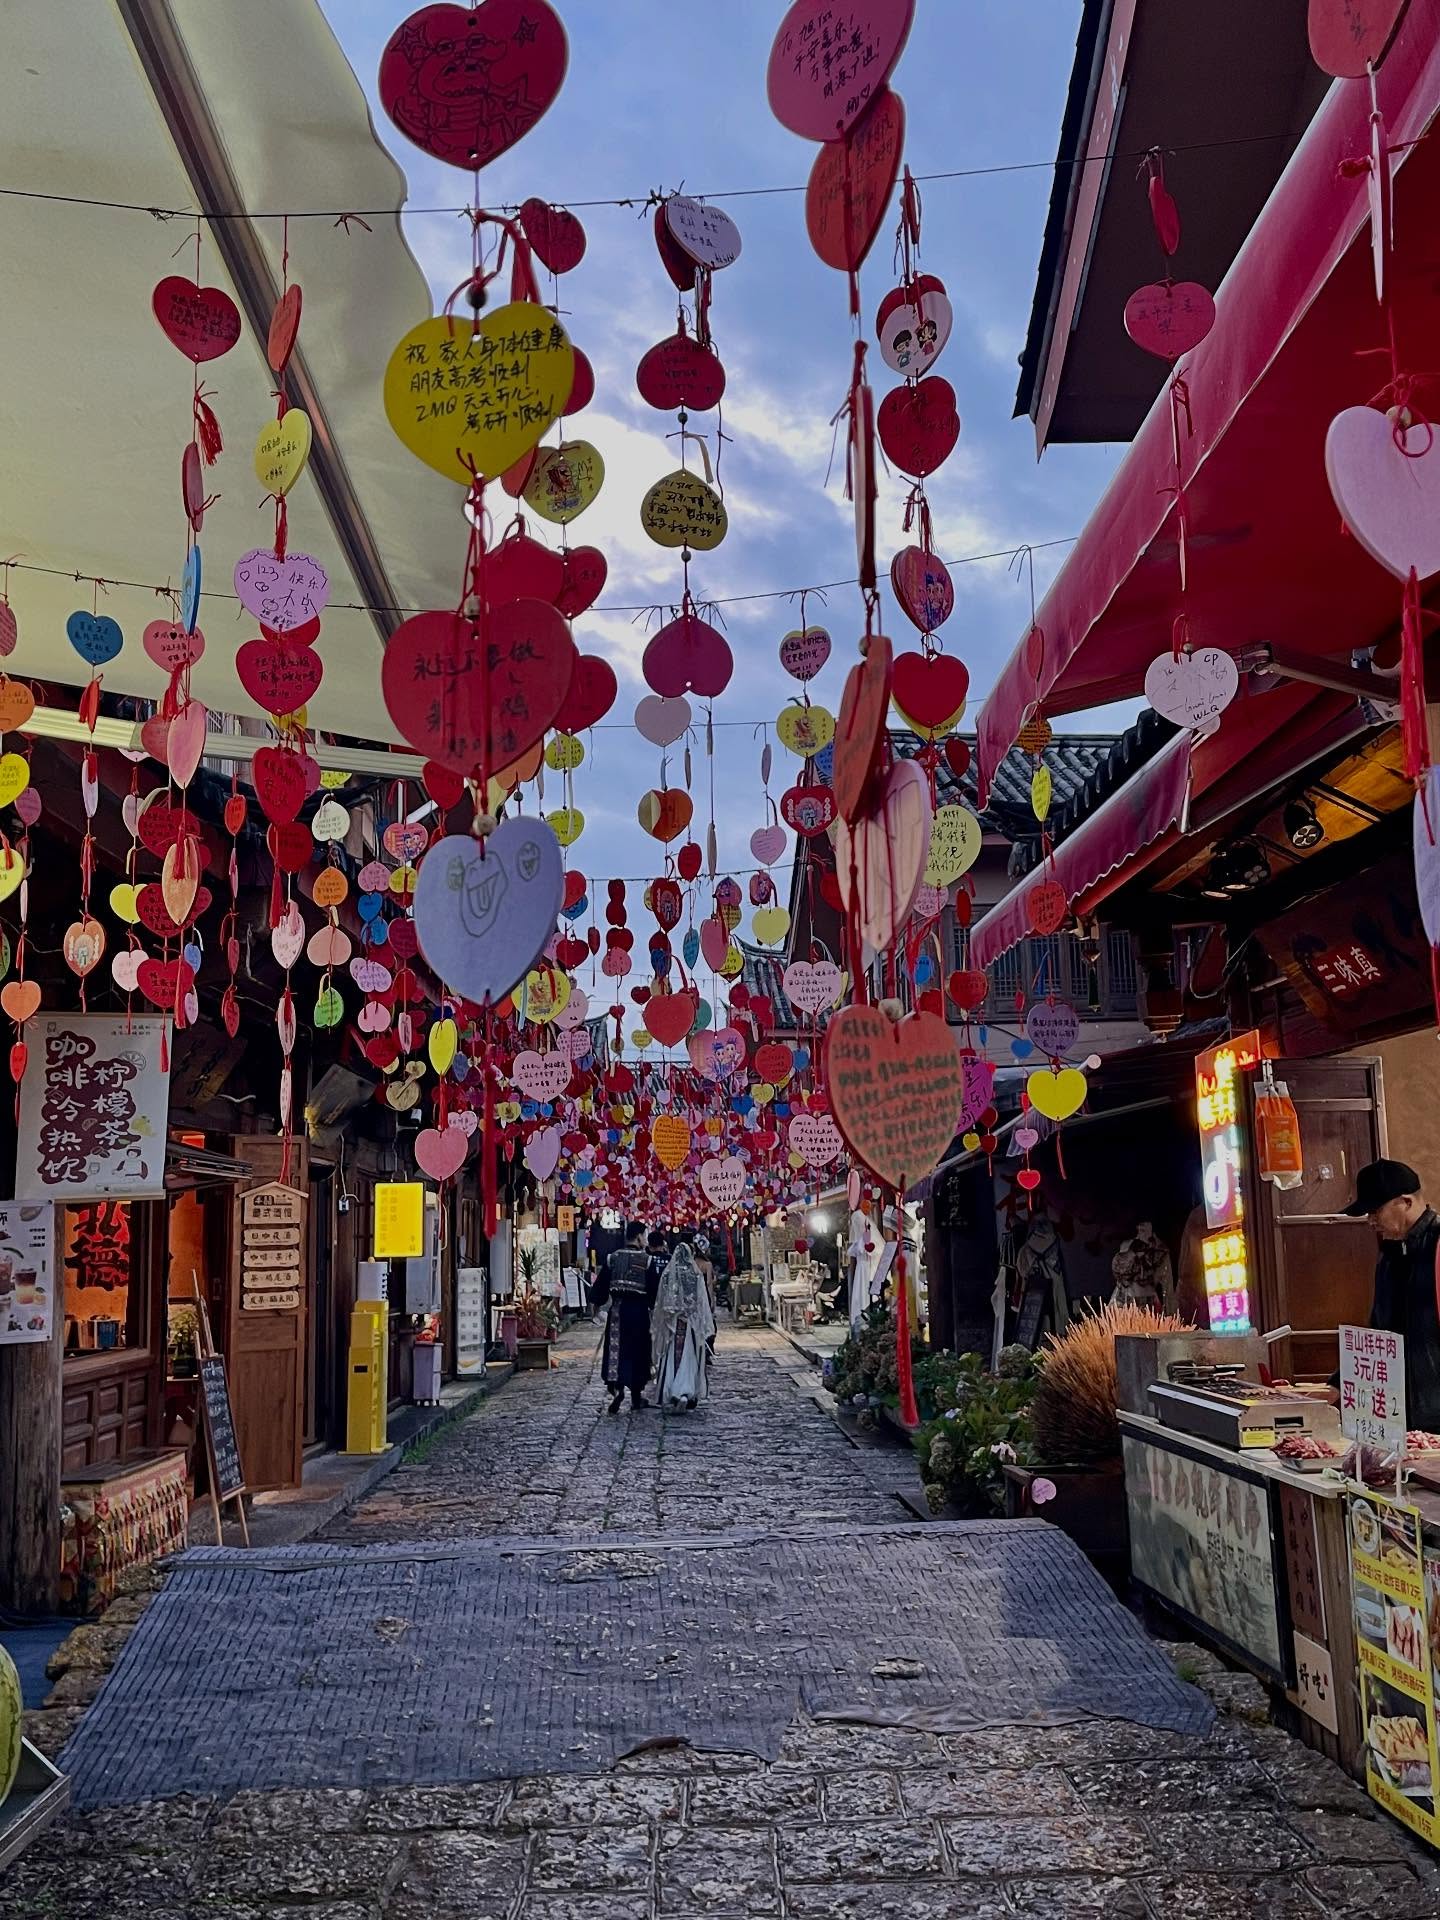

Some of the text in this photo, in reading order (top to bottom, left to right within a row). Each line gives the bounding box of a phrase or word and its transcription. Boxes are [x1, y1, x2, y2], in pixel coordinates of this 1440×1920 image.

[405, 323, 565, 366] 祝 家人身体健康
[90, 1062, 131, 1147] 柠檬茶
[1344, 1329, 1397, 1359] 雪山牦牛肉
[1353, 1355, 1388, 1384] 3元/串
[1298, 1662, 1326, 1701] 好吃
